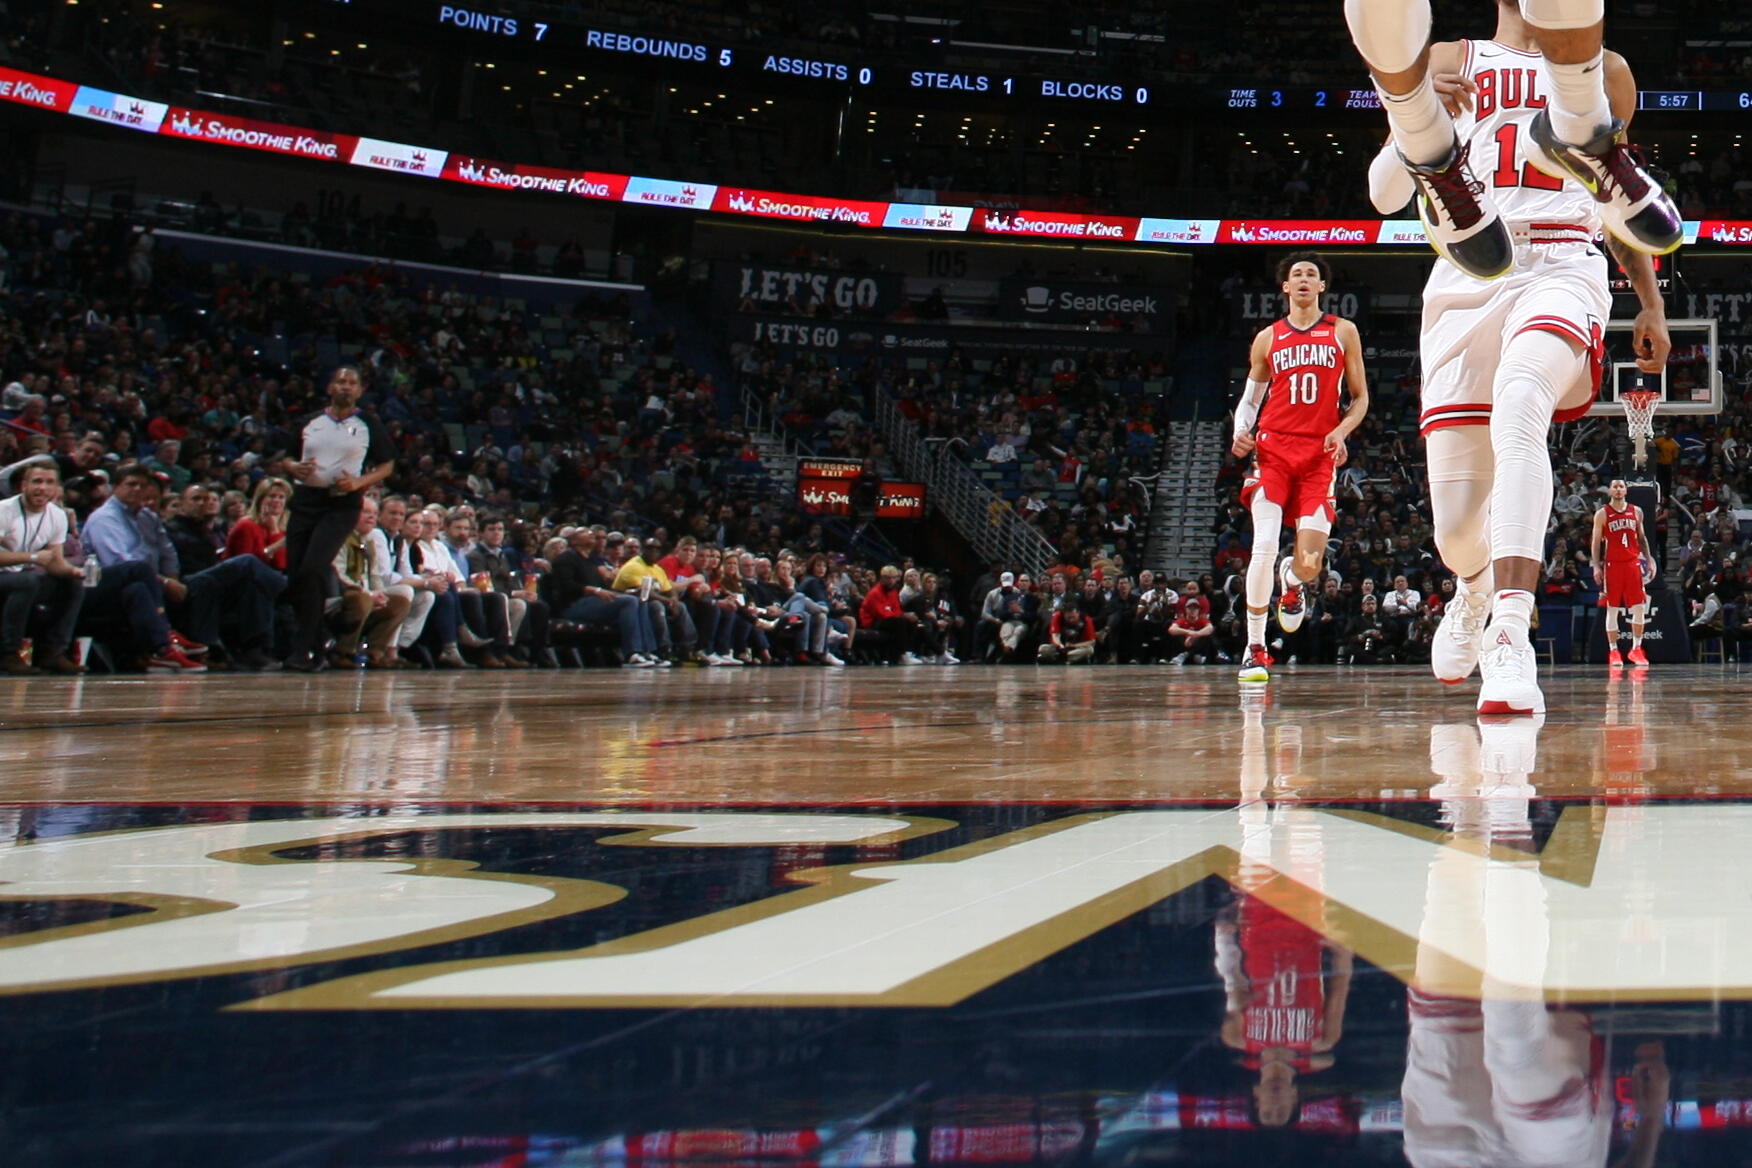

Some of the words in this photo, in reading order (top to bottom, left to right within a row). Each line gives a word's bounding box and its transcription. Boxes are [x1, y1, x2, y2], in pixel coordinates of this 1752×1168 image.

[438, 4, 519, 38] POINTS
[533, 21, 549, 42] 7
[586, 28, 707, 63] REBOUNDS
[719, 47, 733, 67] 5
[763, 54, 848, 82] ASSISTS
[858, 66, 872, 85] 0
[910, 70, 989, 92] STEALS
[1002, 78, 1013, 95] 1
[1040, 80, 1123, 102] BLOCKS
[1136, 87, 1148, 104] 0
[1228, 99, 1257, 108] OUTS
[1230, 89, 1257, 99] TIME
[1271, 91, 1282, 107] 3
[1315, 91, 1326, 107] 2
[1345, 99, 1382, 108] FOULS
[1659, 95, 1688, 107] 5:57
[926, 249, 967, 278] 105
[739, 267, 828, 307] LET'S
[833, 276, 879, 309] GO
[1060, 291, 1157, 315] SeatGeek
[812, 327, 839, 348] GO
[1272, 344, 1336, 374] PELICANS
[1288, 372, 1318, 405] 10
[803, 461, 863, 472] EMERGENCY
[820, 470, 843, 478] EXIT
[1621, 532, 1629, 548] 4
